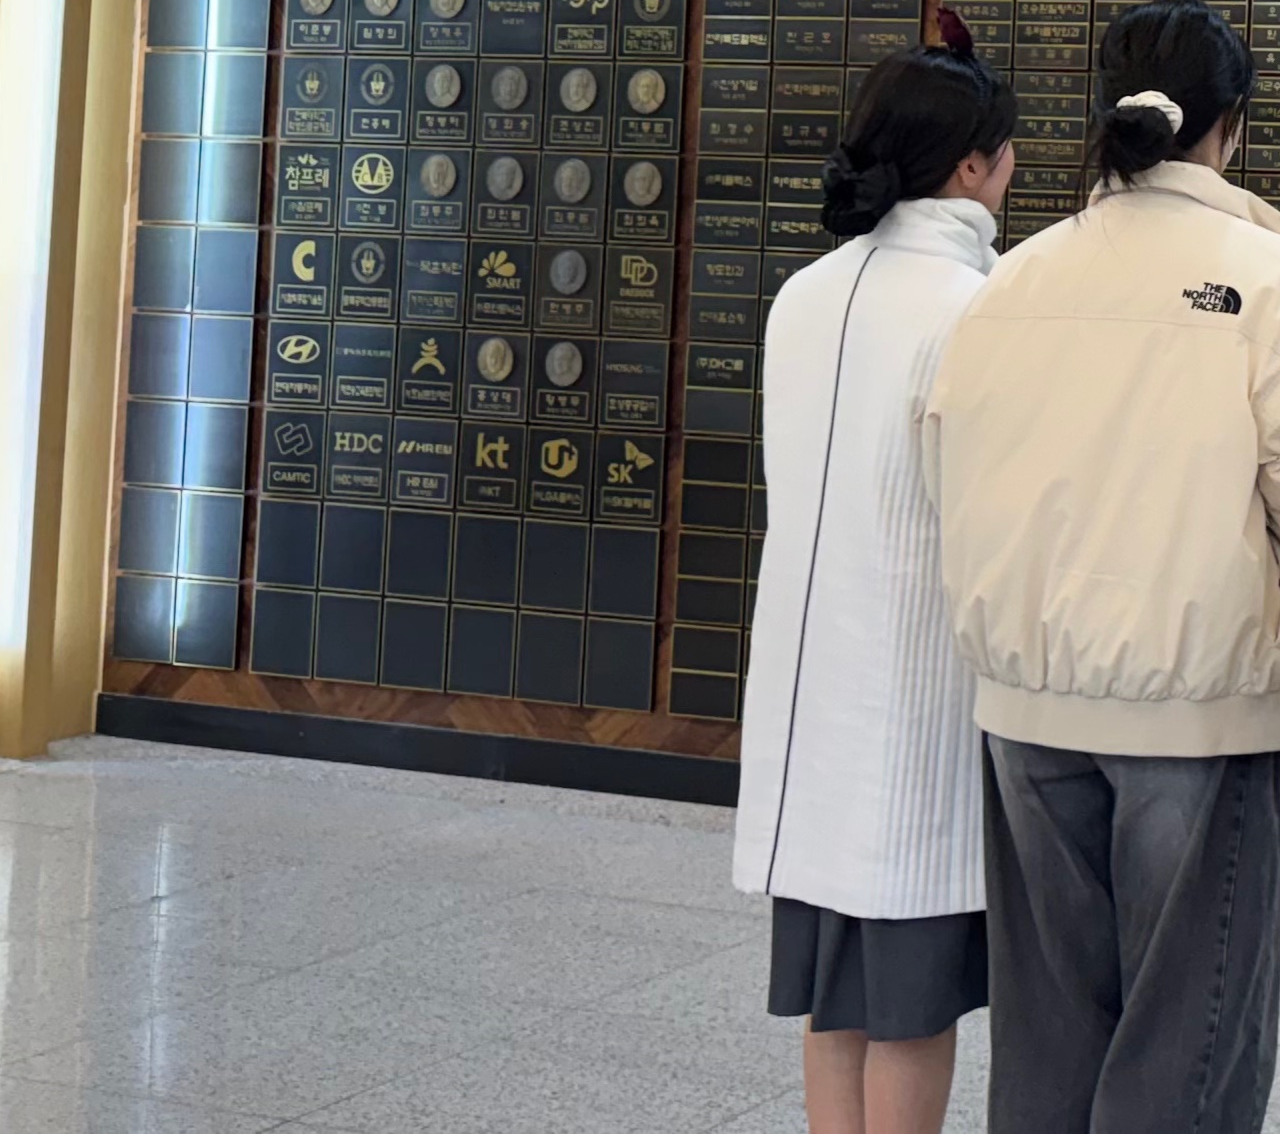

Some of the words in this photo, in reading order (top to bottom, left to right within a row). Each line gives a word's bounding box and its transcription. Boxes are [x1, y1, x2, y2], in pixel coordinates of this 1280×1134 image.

[285, 166, 329, 190] 참프레
[486, 278, 521, 289] SMART
[1204, 282, 1224, 293] THE
[1182, 289, 1222, 303] NORTH
[1191, 300, 1220, 313] FACE
[335, 432, 383, 453] HDC
[476, 432, 509, 469] kt
[273, 471, 310, 483] CAMTIC
[607, 463, 633, 483] SK
